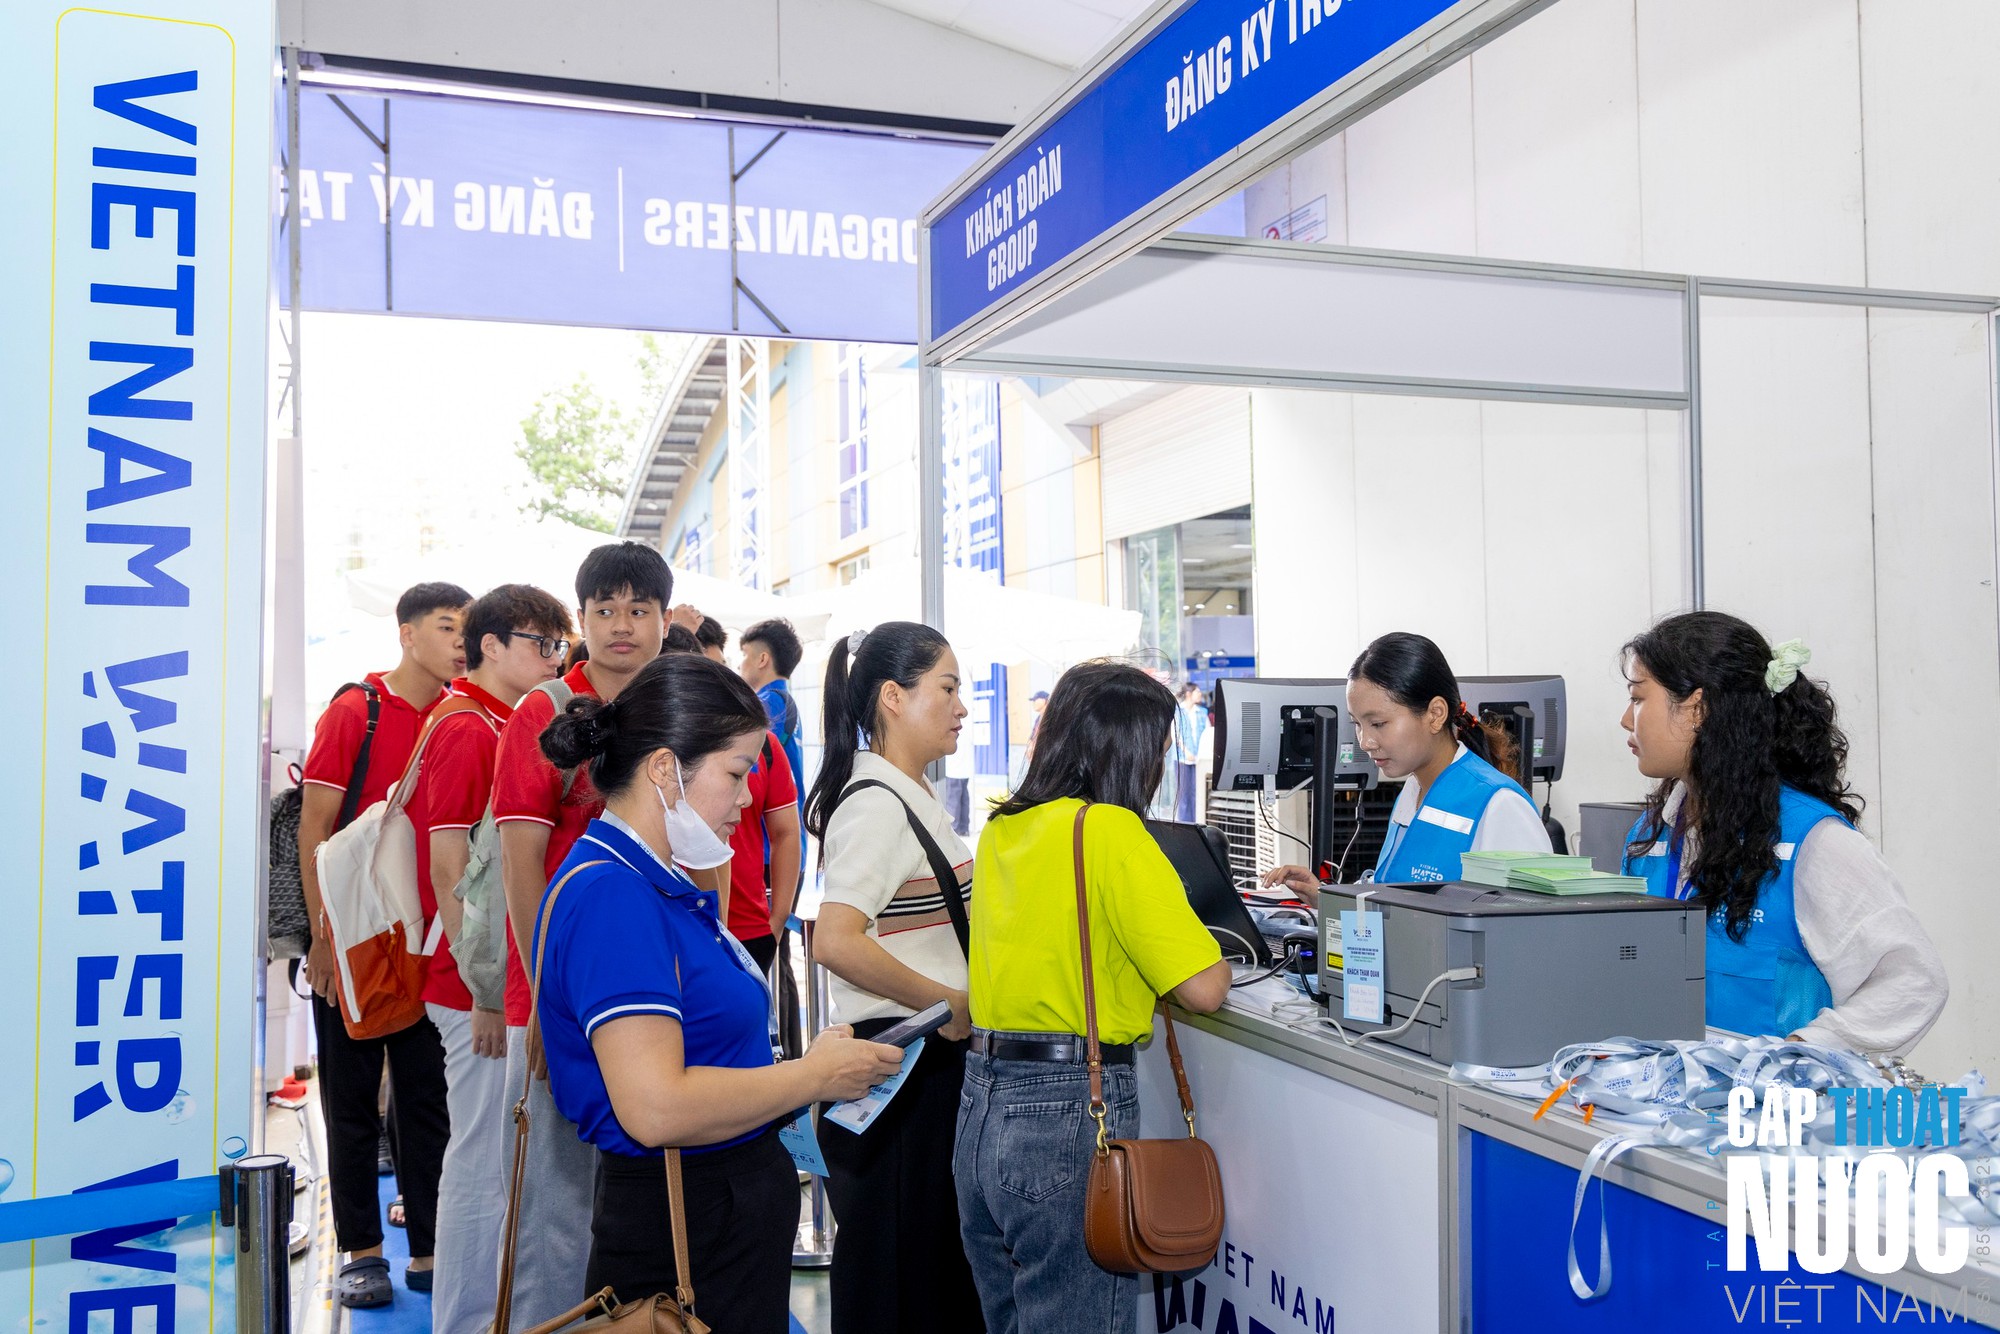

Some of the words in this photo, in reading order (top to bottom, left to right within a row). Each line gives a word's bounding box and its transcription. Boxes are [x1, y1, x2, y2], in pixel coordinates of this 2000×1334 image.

[1165, 35, 1232, 133] ĐĂNG
[965, 187, 1013, 259] KHÁCH
[1016, 143, 1062, 221] ĐOÀN
[987, 219, 1038, 292] GROUP
[84, 69, 198, 607] VIETNAM
[73, 650, 189, 1123] WATER
[1271, 1269, 1335, 1334] NAM
